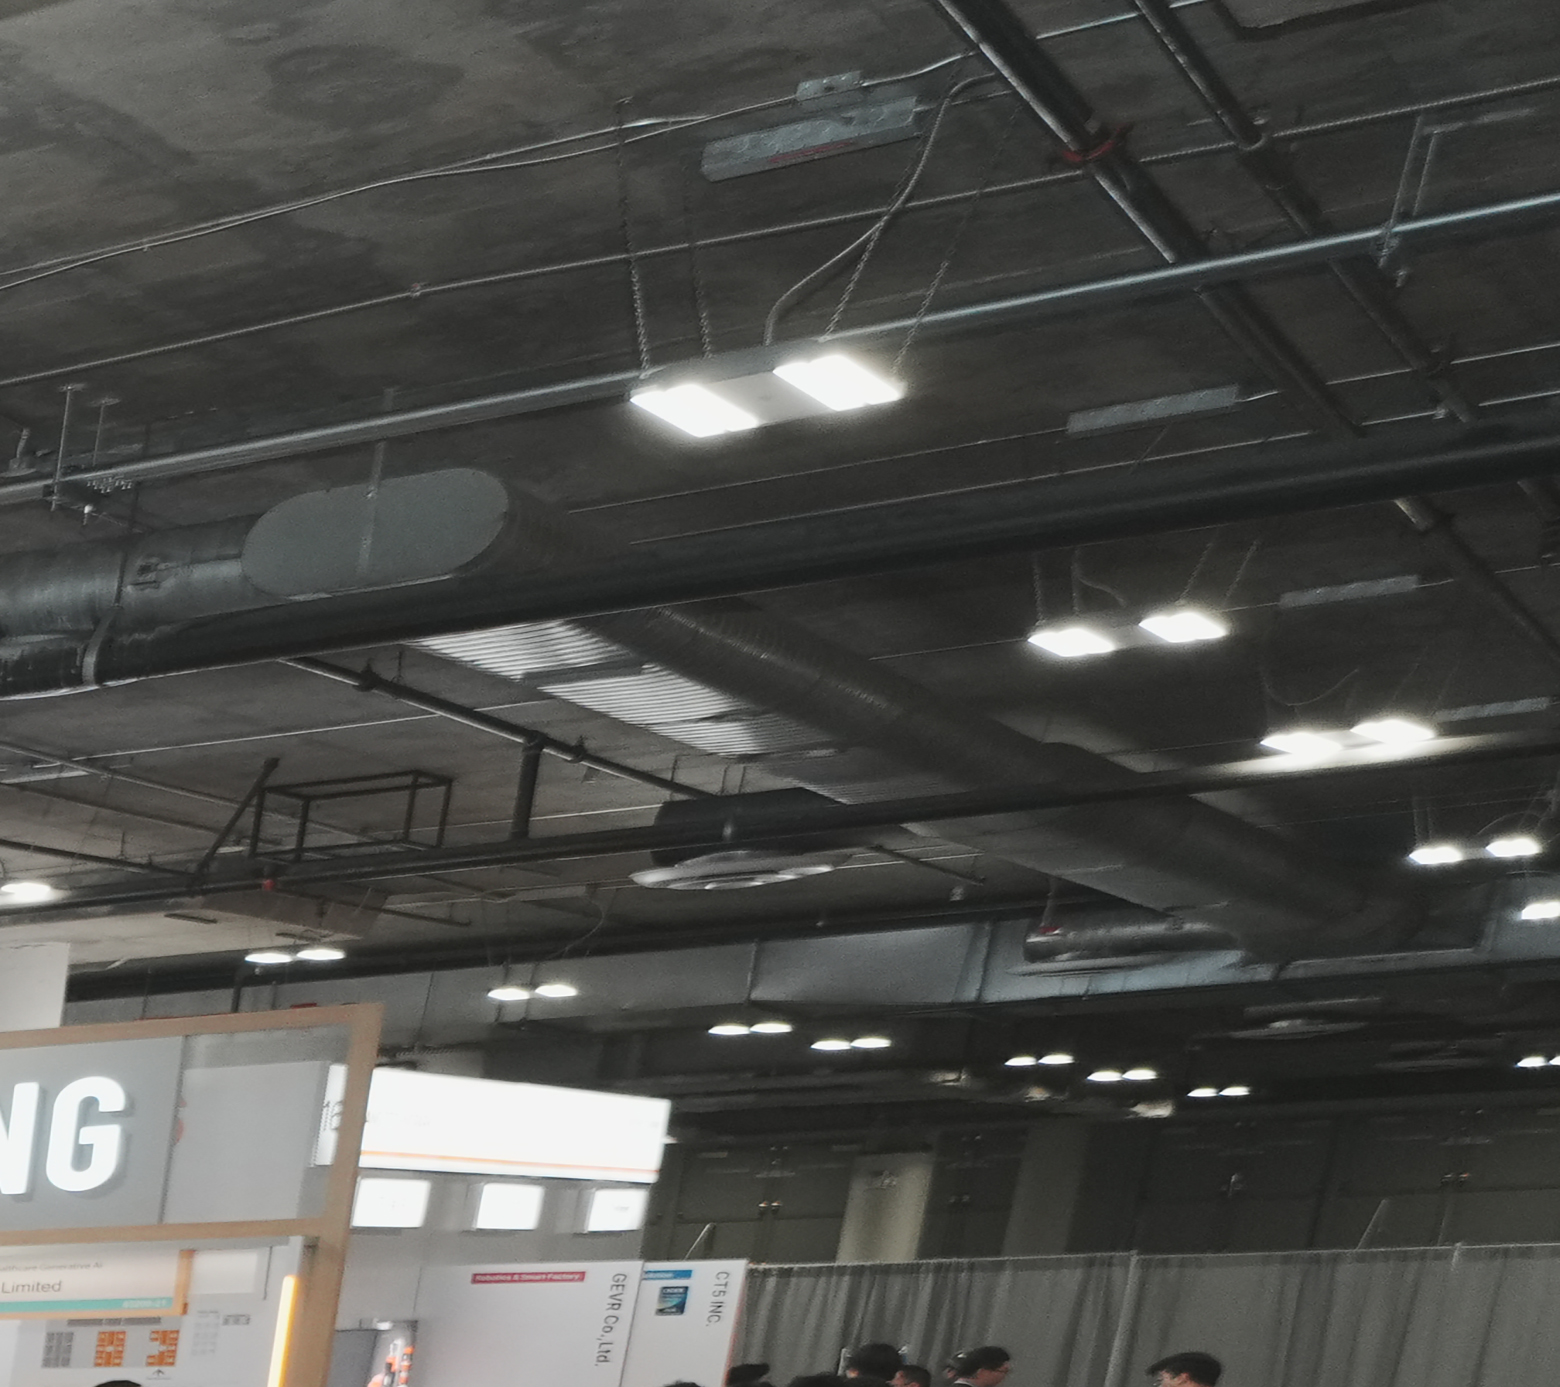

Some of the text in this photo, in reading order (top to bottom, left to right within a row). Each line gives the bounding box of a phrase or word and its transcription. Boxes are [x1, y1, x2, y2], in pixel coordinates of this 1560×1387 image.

[1, 1280, 62, 1294] Limited
[604, 1273, 628, 1312] GEVR
[706, 1301, 724, 1327] INC.
